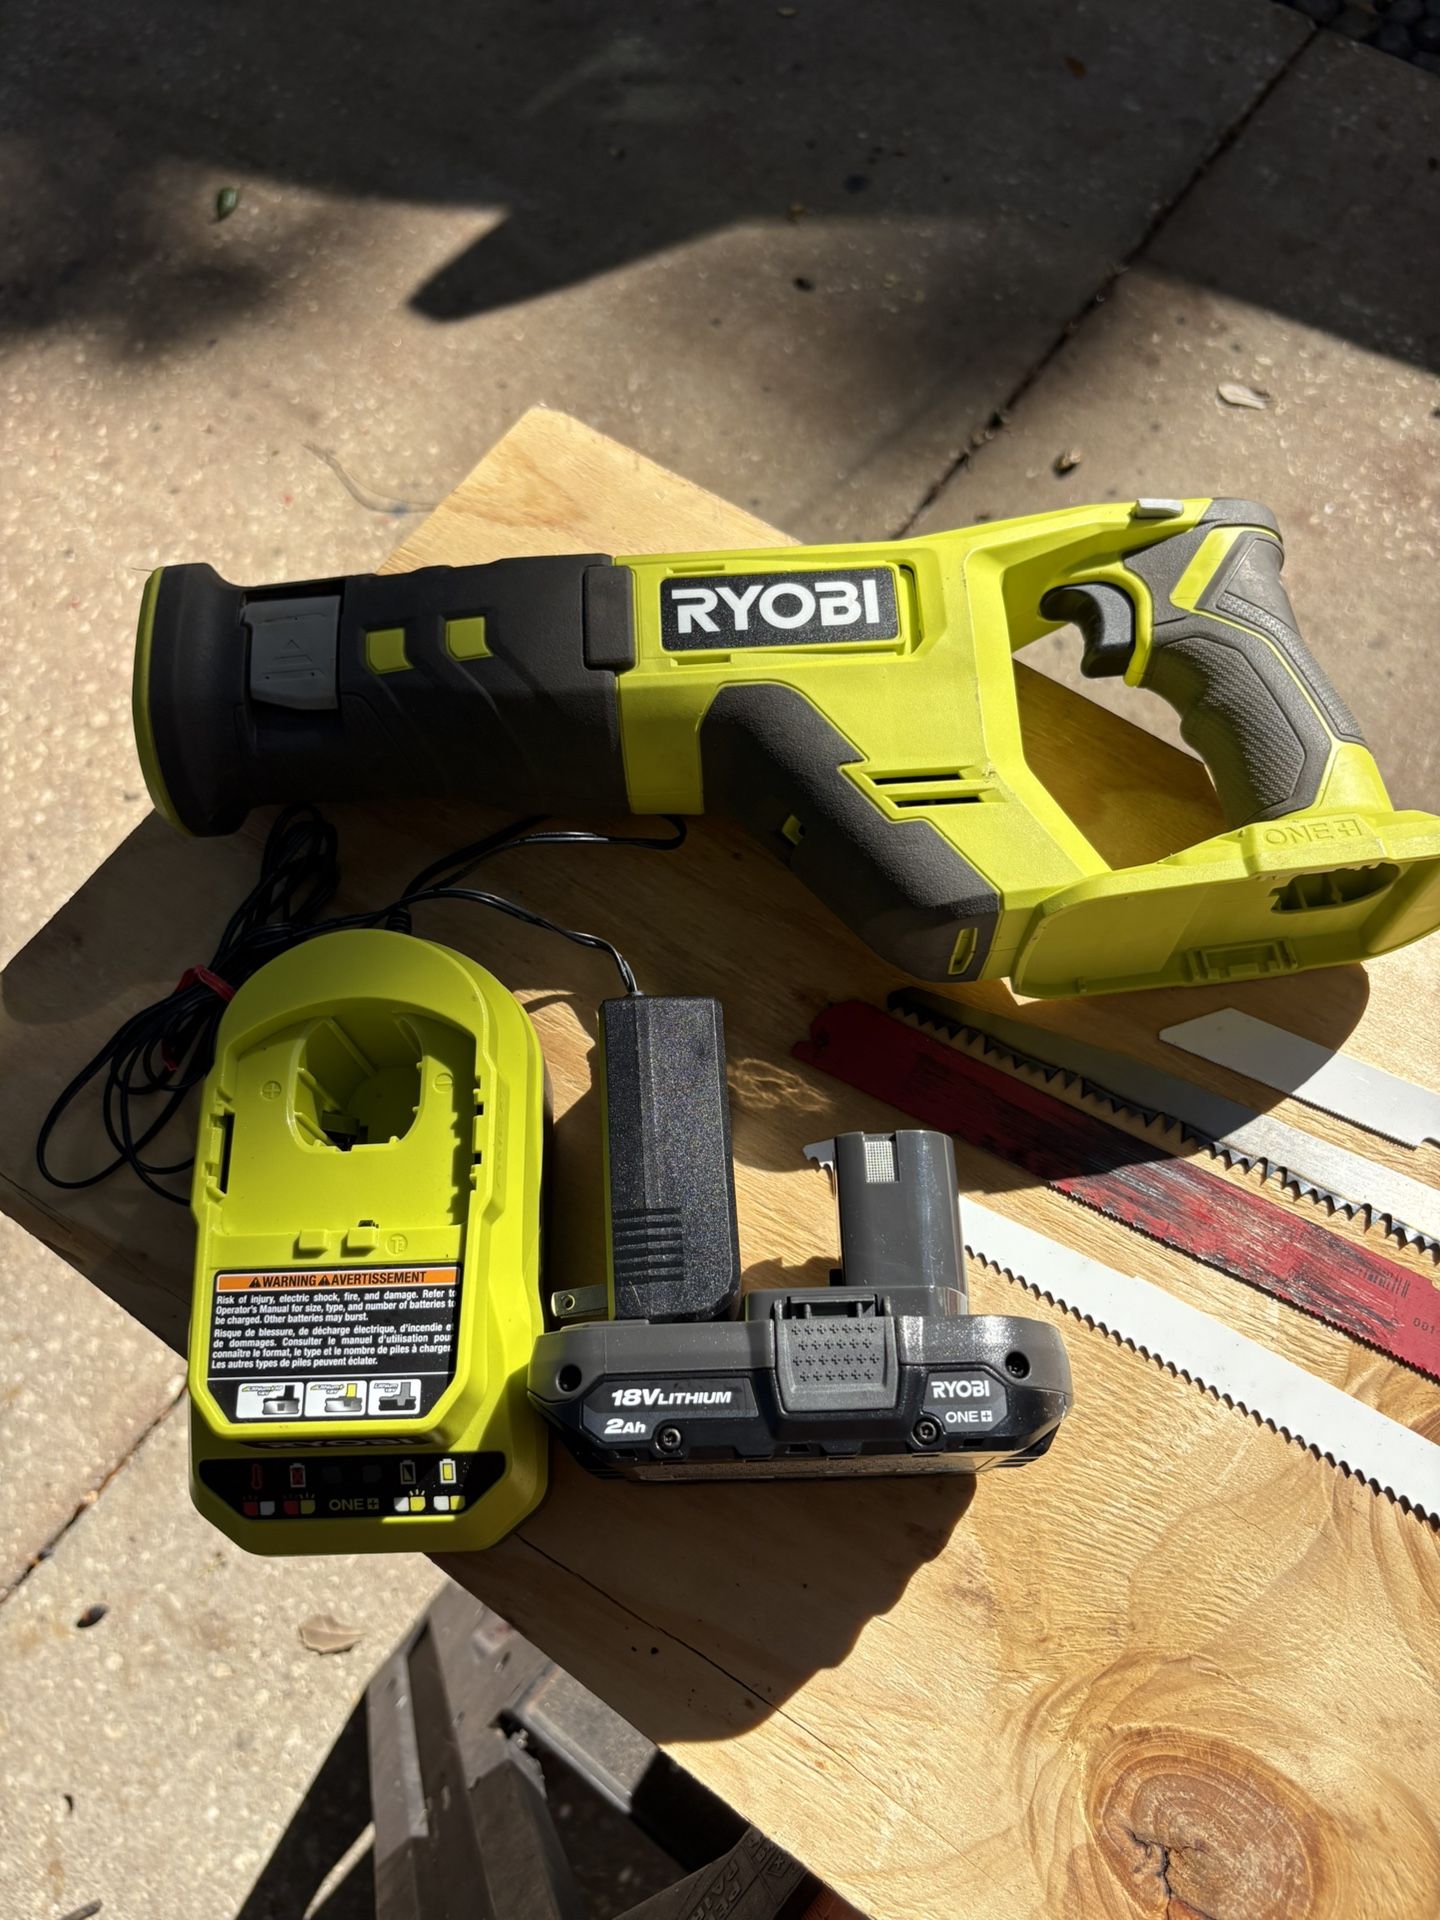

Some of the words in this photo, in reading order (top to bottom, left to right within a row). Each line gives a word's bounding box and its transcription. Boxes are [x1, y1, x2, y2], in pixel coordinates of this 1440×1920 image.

[671, 579, 880, 634] RYOBI
[263, 1275, 316, 1287] WARNING
[332, 1271, 426, 1285] AVERTISSEMENT
[217, 1296, 234, 1304] Risk
[238, 1295, 247, 1304] of
[251, 1295, 275, 1305] injury,
[279, 1294, 309, 1303] electric
[314, 1293, 340, 1302] shock,
[344, 1291, 360, 1301] fire,
[364, 1291, 380, 1300] and
[384, 1290, 418, 1301] damage.
[423, 1289, 445, 1298] Refer
[216, 1305, 257, 1315] Operator's
[260, 1304, 289, 1313] Manual
[292, 1304, 303, 1312] for
[305, 1304, 323, 1313] size,
[326, 1303, 345, 1313] type,
[348, 1302, 363, 1310] and
[366, 1301, 396, 1310] number
[399, 1300, 407, 1309] of
[410, 1300, 445, 1308] batteries
[215, 1316, 225, 1324] be
[227, 1315, 262, 1325] charged.
[264, 1314, 285, 1323] Other
[288, 1314, 323, 1322] batteries
[325, 1314, 342, 1323] may
[345, 1312, 368, 1321] burst.
[214, 1329, 242, 1338] Risque
[245, 1328, 255, 1336] de
[259, 1327, 295, 1337] blessure,
[299, 1326, 309, 1335] de
[312, 1325, 350, 1335] décharge
[354, 1324, 396, 1334] électrique,
[400, 1323, 442, 1332] d'incendie
[213, 1339, 223, 1348] de
[230, 1339, 277, 1349] dommages.
[282, 1337, 322, 1346] Consulter
[328, 1337, 336, 1345] le
[342, 1335, 372, 1344] manuel
[378, 1334, 428, 1343] d'utilisation
[213, 1349, 250, 1358] connaître
[253, 1348, 260, 1357] le
[262, 1348, 292, 1357] format,
[294, 1347, 301, 1356] le
[304, 1348, 321, 1357] type
[324, 1347, 332, 1355] et
[334, 1346, 341, 1355] le
[344, 1345, 375, 1354] nombre
[378, 1345, 387, 1354] de
[390, 1345, 409, 1355] piles
[412, 1344, 417, 1353] à
[212, 1360, 226, 1369] Les
[228, 1360, 253, 1368] autres
[256, 1359, 277, 1369] types
[280, 1359, 289, 1367] de
[292, 1358, 311, 1368] piles
[314, 1358, 346, 1368] peuvent
[348, 1357, 378, 1365] éclater.
[931, 1380, 990, 1398] RYOBI
[604, 1418, 646, 1434] 2Ah
